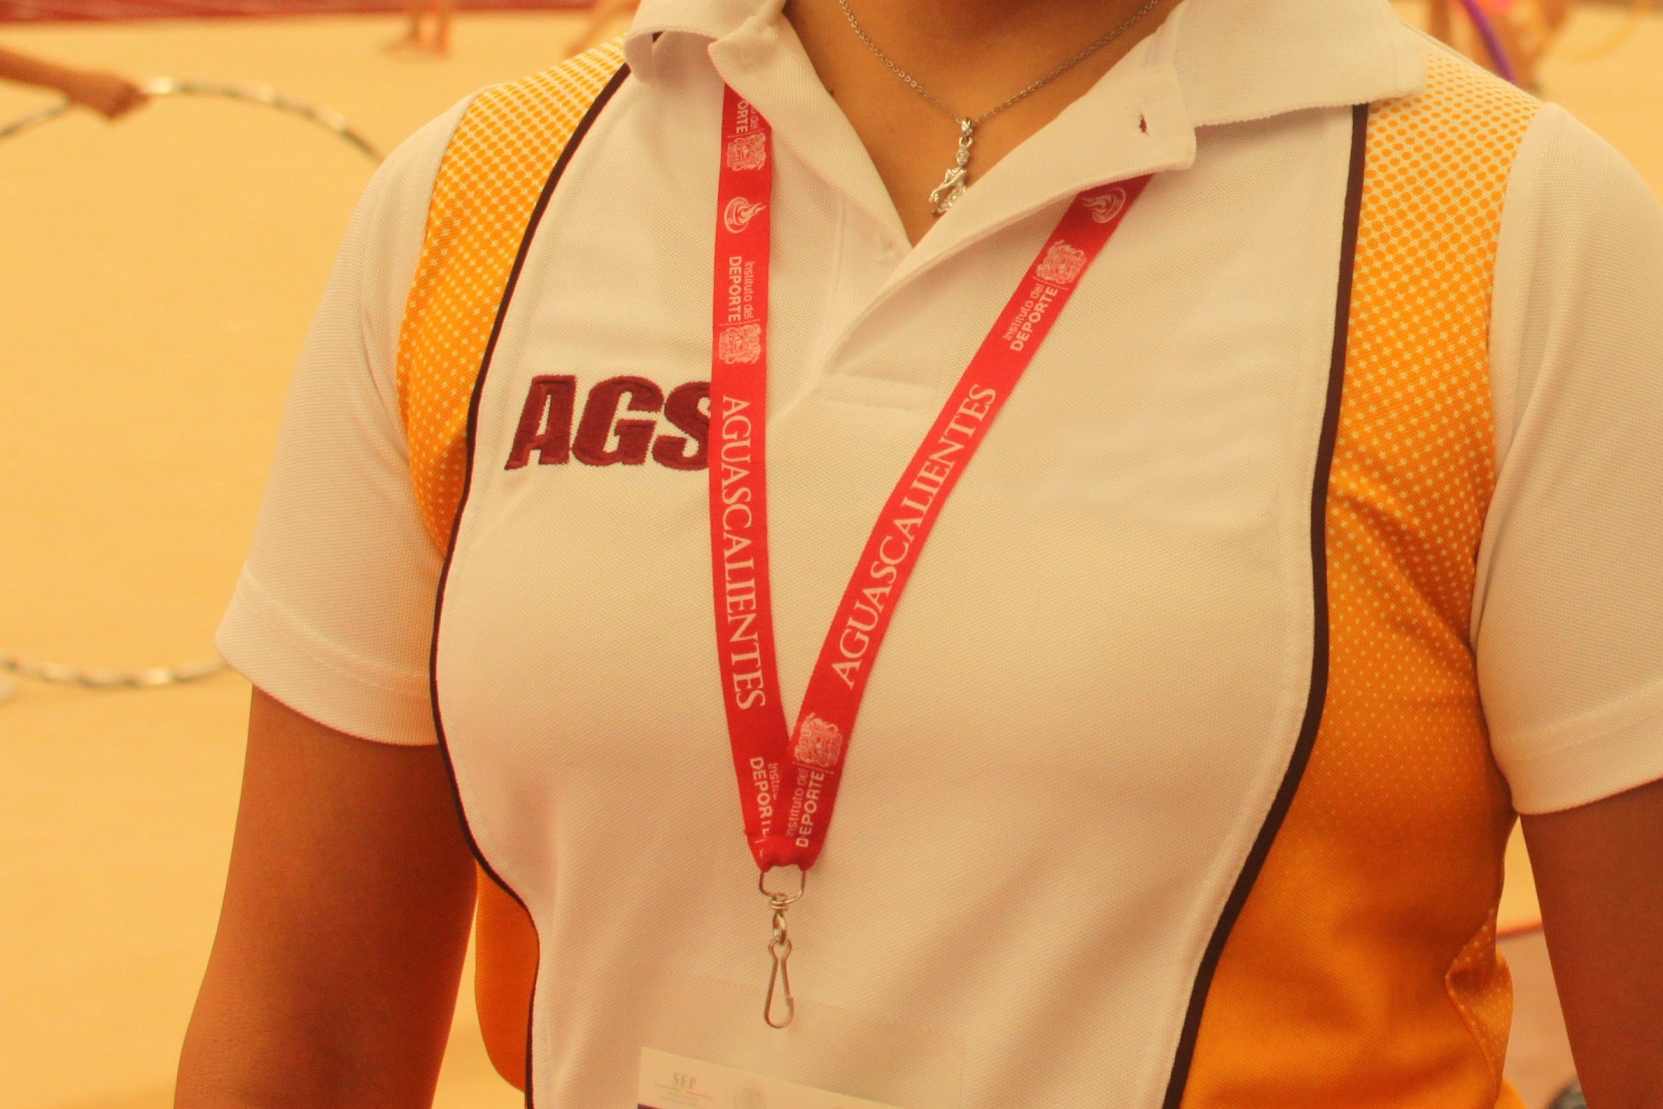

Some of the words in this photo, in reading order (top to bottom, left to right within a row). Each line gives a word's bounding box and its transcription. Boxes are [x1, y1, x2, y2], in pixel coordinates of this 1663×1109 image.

[727, 256, 743, 323] DEPORTE
[743, 261, 755, 302] Instituto
[743, 304, 755, 320] del
[1002, 300, 1034, 341] Instituto
[1030, 283, 1045, 300] del
[1009, 286, 1059, 352] DEPORTE
[504, 375, 711, 471] AGS
[721, 395, 766, 710] AGUASCALIENTES
[832, 383, 997, 690] AGUASCALIENTES
[785, 788, 804, 837] Instituto
[795, 771, 825, 848] DEPORTE
[672, 1072, 698, 1089] SEP
